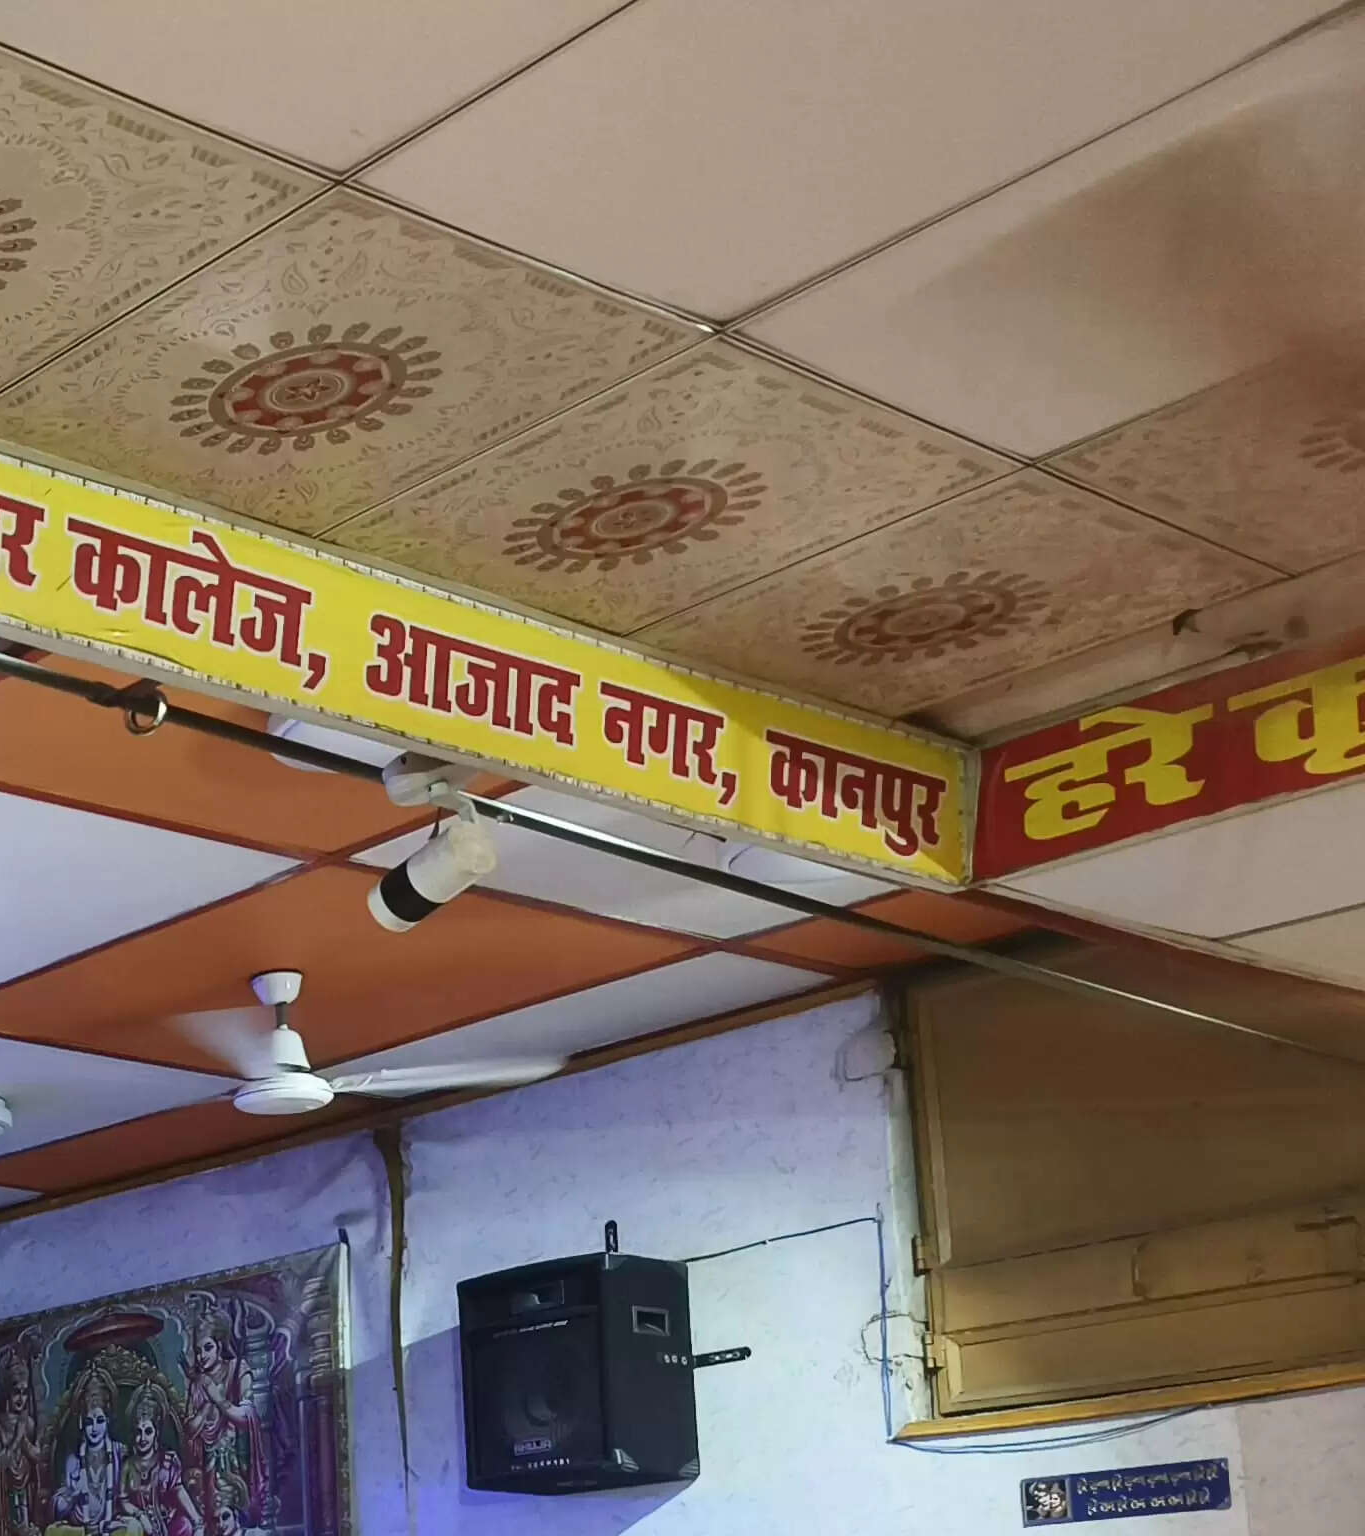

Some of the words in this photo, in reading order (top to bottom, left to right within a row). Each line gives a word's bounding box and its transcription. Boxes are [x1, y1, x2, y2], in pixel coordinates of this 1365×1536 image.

[67, 516, 327, 690] कालेज,
[367, 614, 580, 746] आजाद
[600, 682, 737, 805] नगर,
[766, 729, 947, 856] कानपुर
[1004, 703, 1213, 840] हरे
